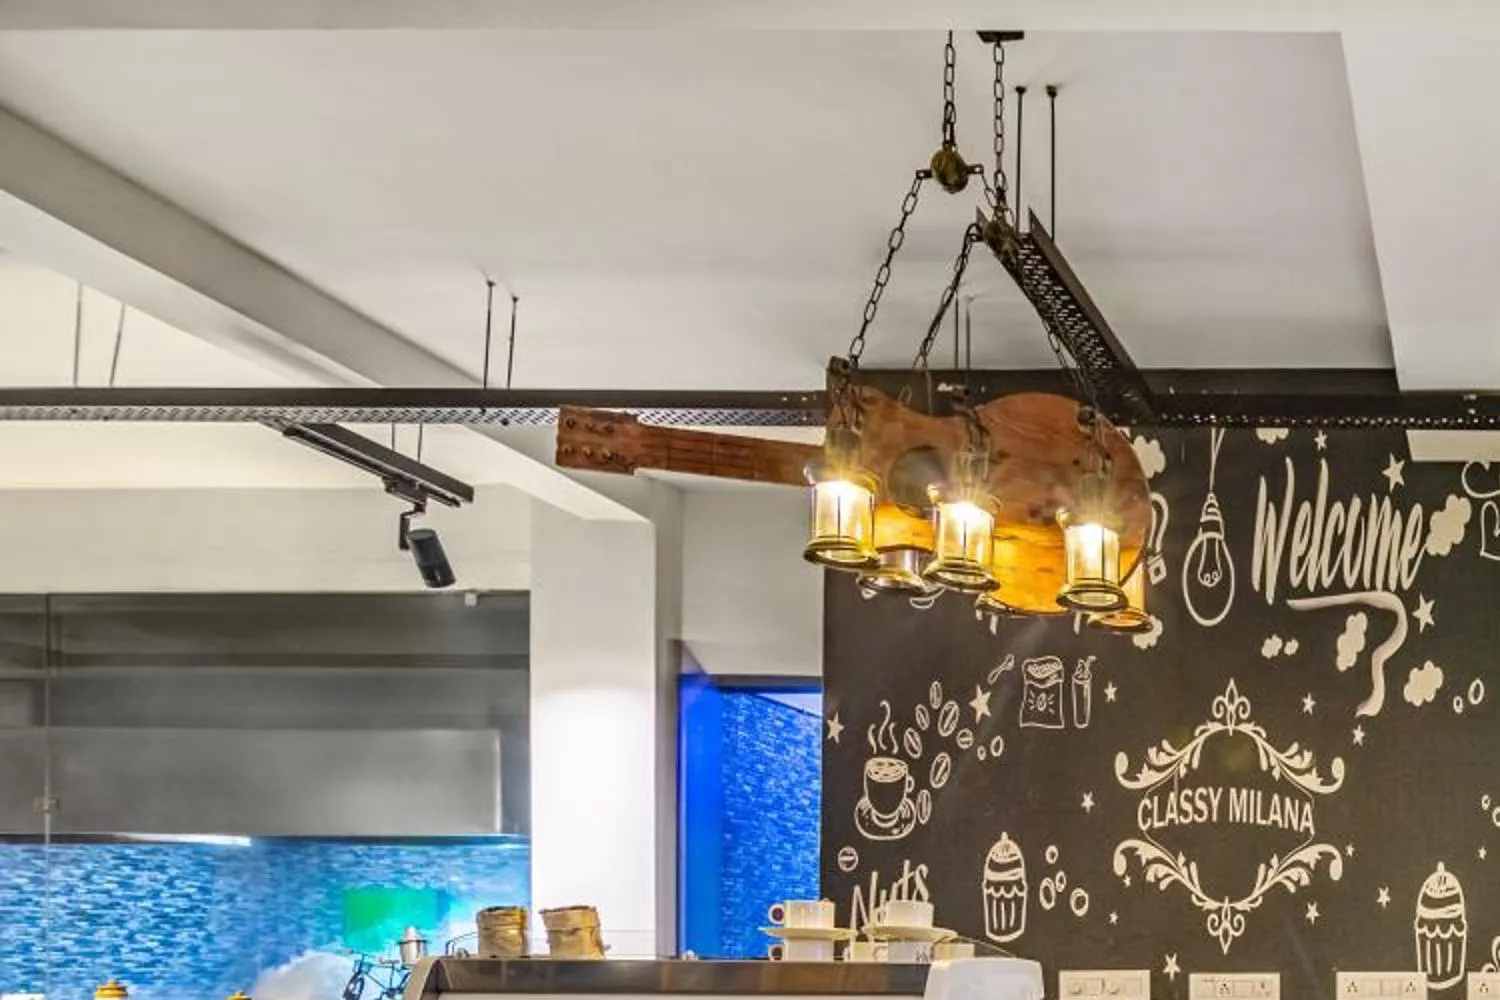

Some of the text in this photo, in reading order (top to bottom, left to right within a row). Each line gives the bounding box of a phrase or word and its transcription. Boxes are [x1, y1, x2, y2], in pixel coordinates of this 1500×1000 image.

[1252, 456, 1427, 606] Welcome
[1137, 786, 1316, 835] CLASSY MILANA
